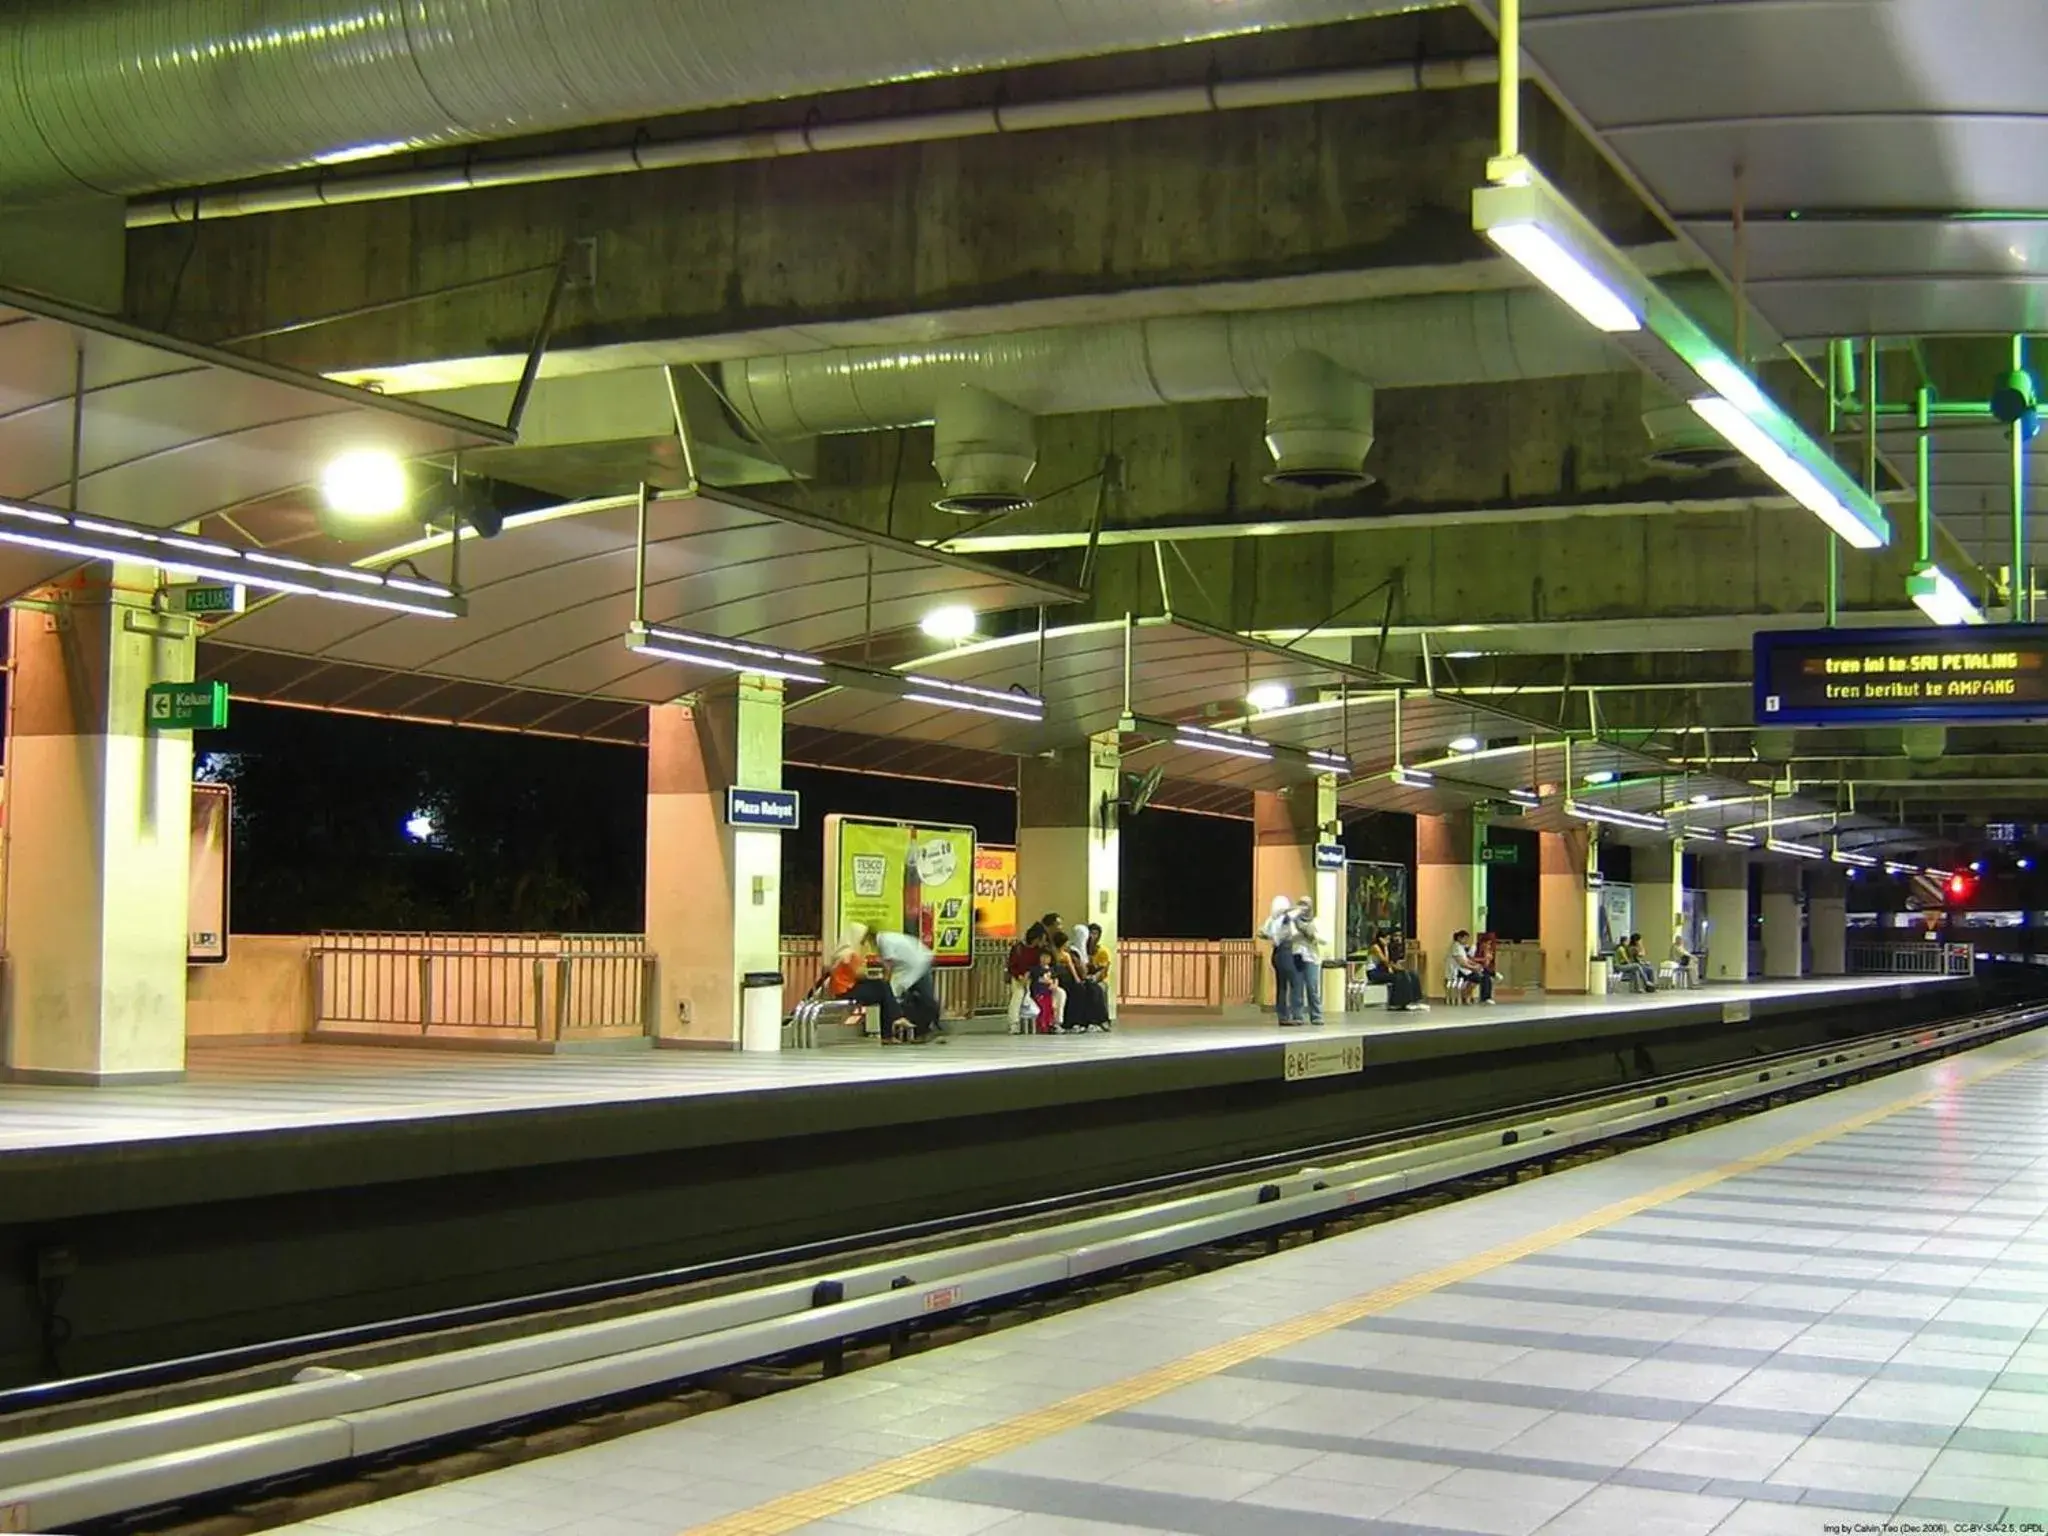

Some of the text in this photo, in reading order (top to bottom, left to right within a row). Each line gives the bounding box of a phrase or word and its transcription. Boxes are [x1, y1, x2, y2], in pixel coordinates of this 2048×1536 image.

[1825, 657, 1861, 674] tren
[1864, 655, 1884, 673] ini
[1942, 652, 2018, 671] PETALING
[1826, 679, 2015, 698] tren berikut ke AMPANG
[176, 692, 212, 706] Keluar
[734, 799, 760, 814] Plaza
